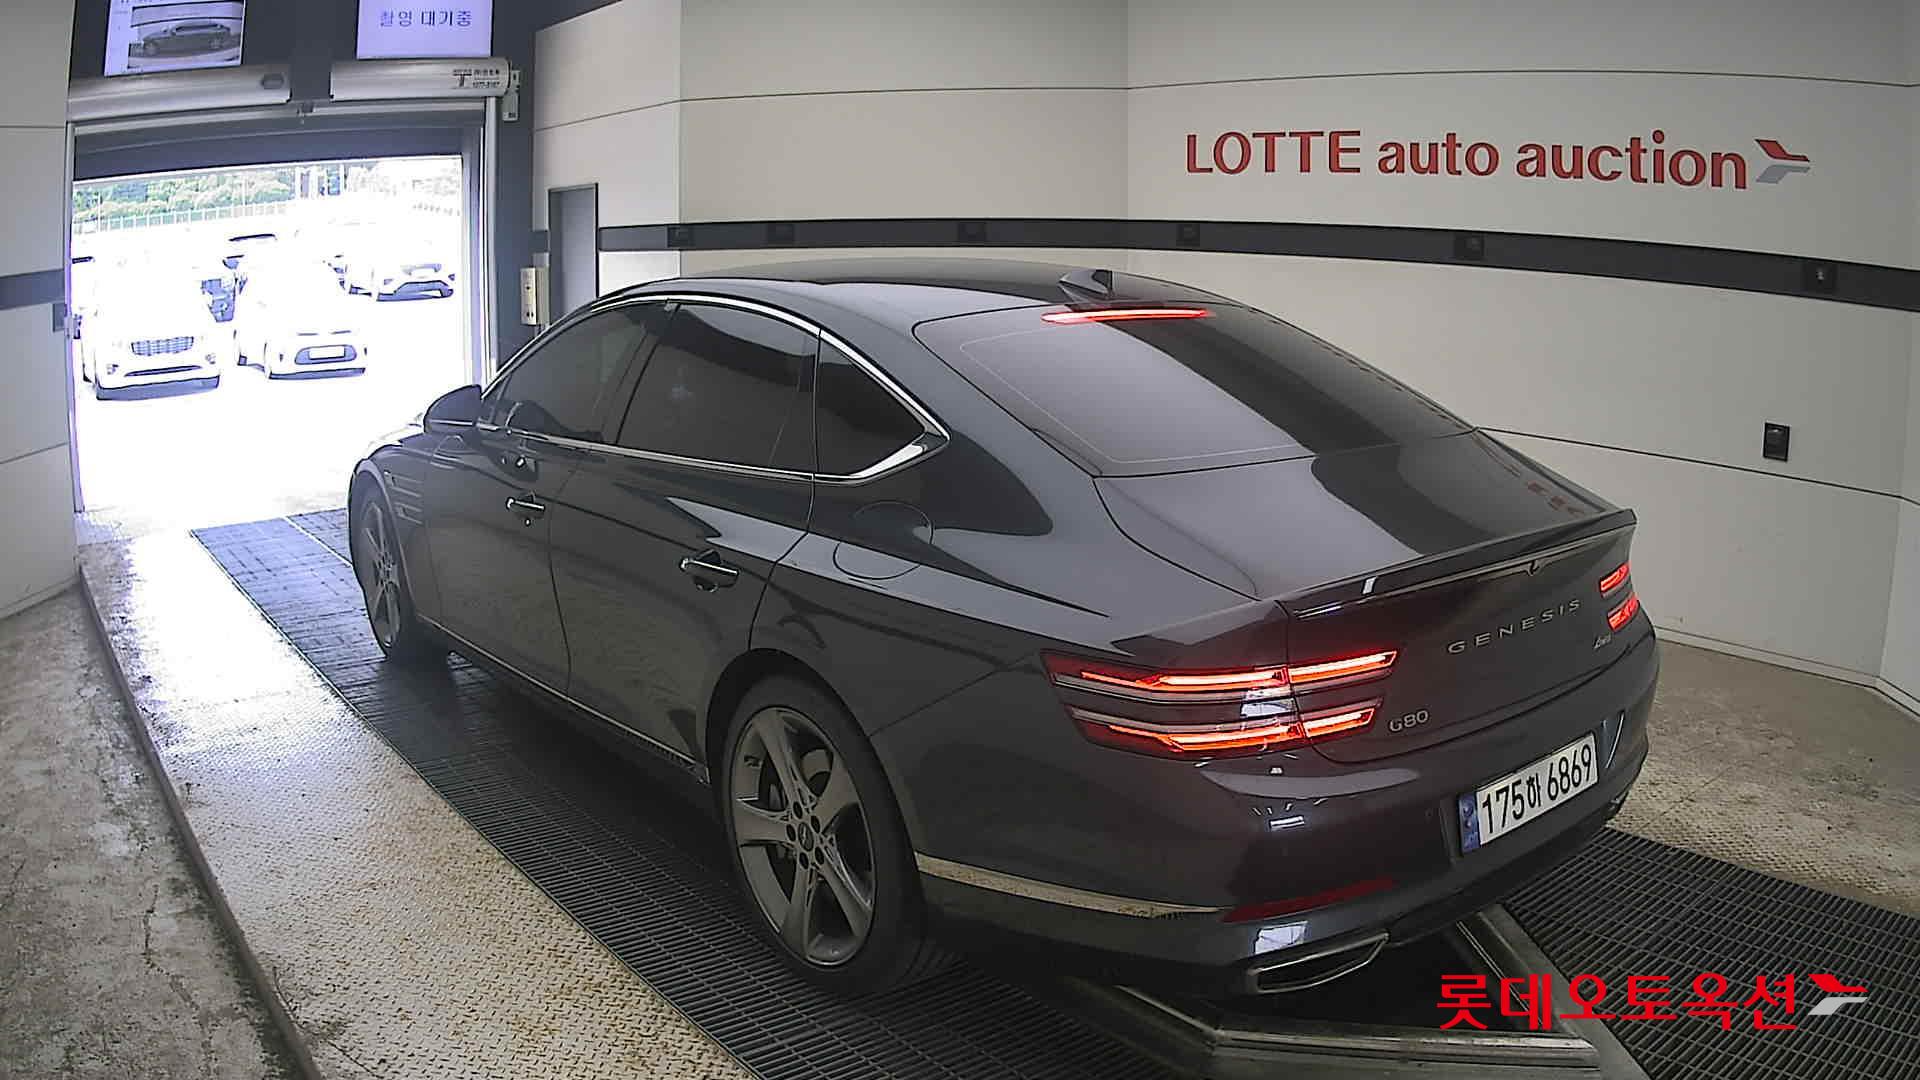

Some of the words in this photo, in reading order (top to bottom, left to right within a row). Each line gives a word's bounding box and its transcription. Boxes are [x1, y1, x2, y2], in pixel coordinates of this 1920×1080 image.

[421, 10, 471, 27] 대기중
[1186, 130, 1361, 175] LOTTE
[1377, 132, 1500, 176] auto
[1515, 129, 1748, 189] auction
[1447, 599, 1581, 654] GENESIS
[1389, 709, 1429, 733] G80
